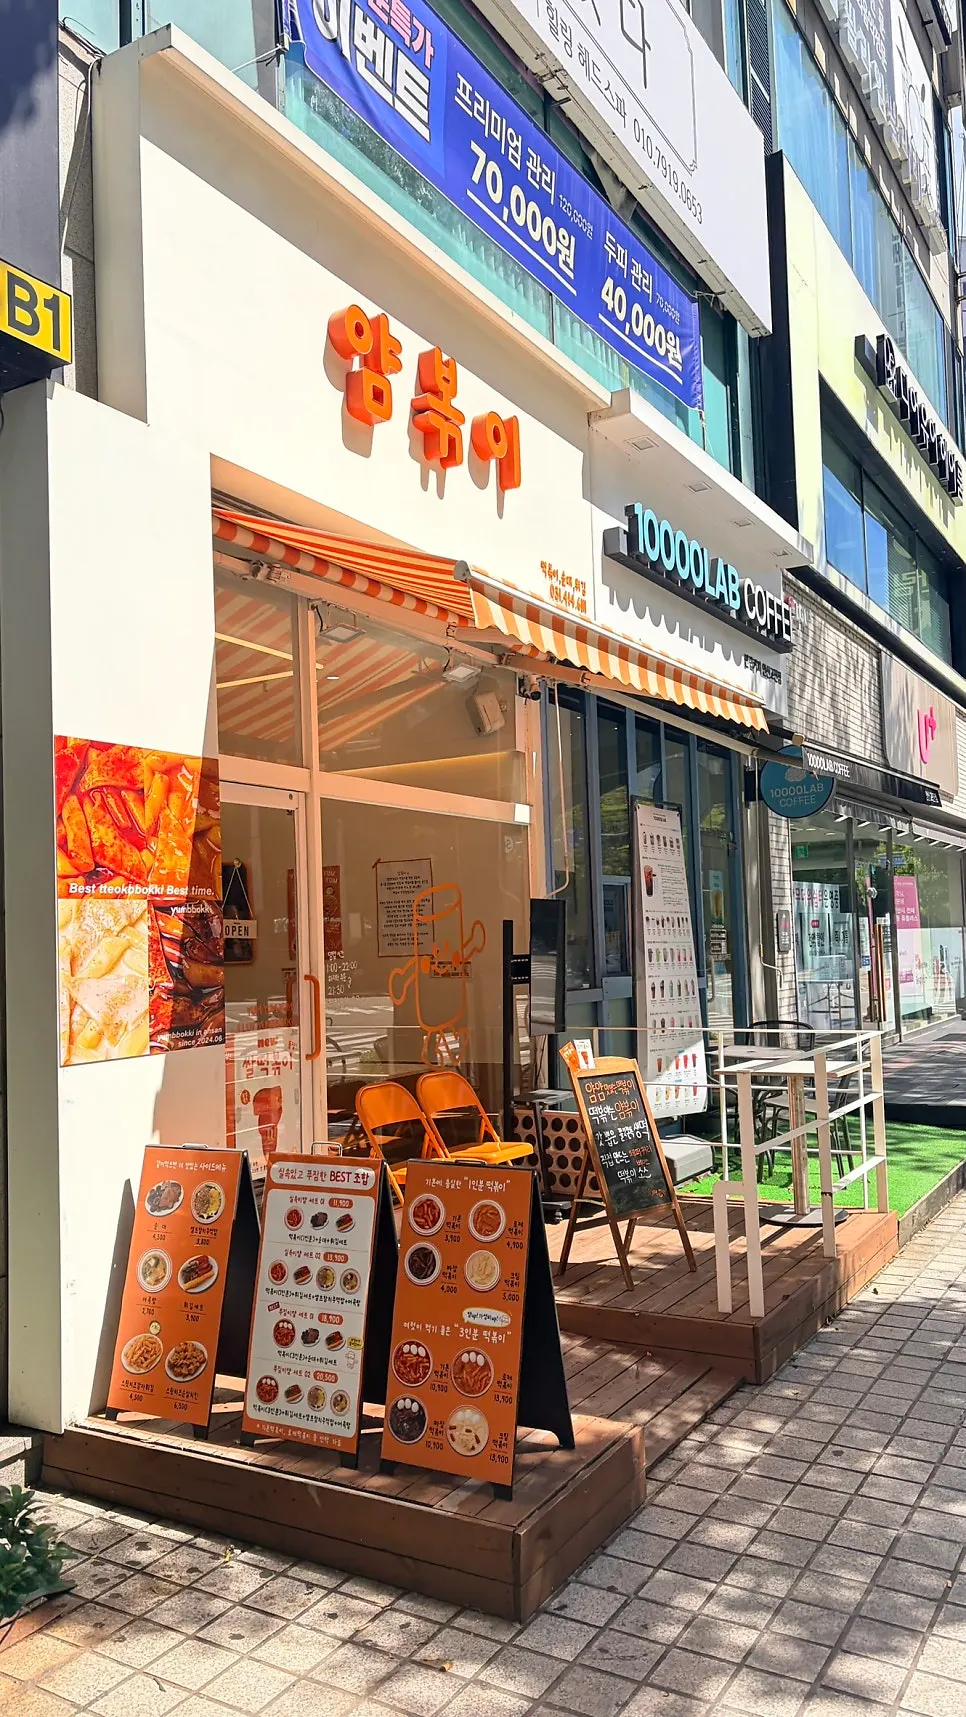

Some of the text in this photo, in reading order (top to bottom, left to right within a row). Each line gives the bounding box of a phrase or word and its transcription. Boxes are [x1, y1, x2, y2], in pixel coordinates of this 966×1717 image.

[578, 43, 627, 128] 헤드스파
[633, 118, 702, 224] 010.7919.0653
[454, 73, 594, 240] 프리미엄 관리 120,000원
[469, 140, 577, 281] 70,000원
[603, 230, 627, 279] 두피
[630, 256, 654, 304] 관리
[7, 269, 60, 352] B1
[600, 277, 684, 371] 40,000원
[327, 304, 522, 490] 얌볶이
[626, 502, 741, 610] 10000LAB
[807, 753, 851, 778] 10000LAB COFFEE
[770, 782, 824, 799] 10000LAB
[779, 794, 817, 808] COFFEE
[69, 882, 216, 897] Best tteokbbokki Best time.
[171, 904, 213, 917] yumbbokki
[224, 925, 249, 937] OPEN
[157, 1030, 195, 1042] yumbbokki
[203, 1027, 223, 1035] ansan
[177, 1036, 223, 1048] since 2024.06
[585, 1081, 606, 1104] 얌얌
[616, 1079, 636, 1097] 떡볶이
[588, 1098, 640, 1125] 떡볶이는 얌볶이
[603, 1129, 619, 1147] 뽑은
[600, 1151, 615, 1168] 직접
[613, 1150, 630, 1164] 만드는
[199, 1163, 227, 1172] 사이드메뉴
[278, 1168, 370, 1185] 실속있고 푸짐한 BEST 조합
[617, 1168, 637, 1184] 떡볶이
[425, 1178, 443, 1187] 기본에
[445, 1178, 462, 1189] 충실한
[308, 1197, 319, 1205] 세트
[452, 1215, 462, 1223] 기본
[446, 1223, 462, 1231] 떡볶이
[508, 1228, 523, 1237] 떡볶이
[506, 1240, 524, 1250] 4,900
[303, 1251, 314, 1259] 세트
[442, 1272, 457, 1281] 떡볶이
[510, 1272, 520, 1280] 크림
[440, 1284, 458, 1294] 4,000
[504, 1279, 520, 1288] 떡볶이
[502, 1292, 520, 1302] 5,000
[298, 1312, 308, 1320] 세트
[403, 1321, 422, 1331] 여럿이
[425, 1324, 438, 1334] 먹기
[440, 1325, 452, 1336] 좋은
[293, 1368, 303, 1377] 세트
[440, 1363, 450, 1371] 기본
[434, 1370, 450, 1379] 떡볶이
[497, 1380, 513, 1390] 떡볶이
[429, 1427, 445, 1437] 떡볶이
[493, 1439, 508, 1450] 떡볶이
